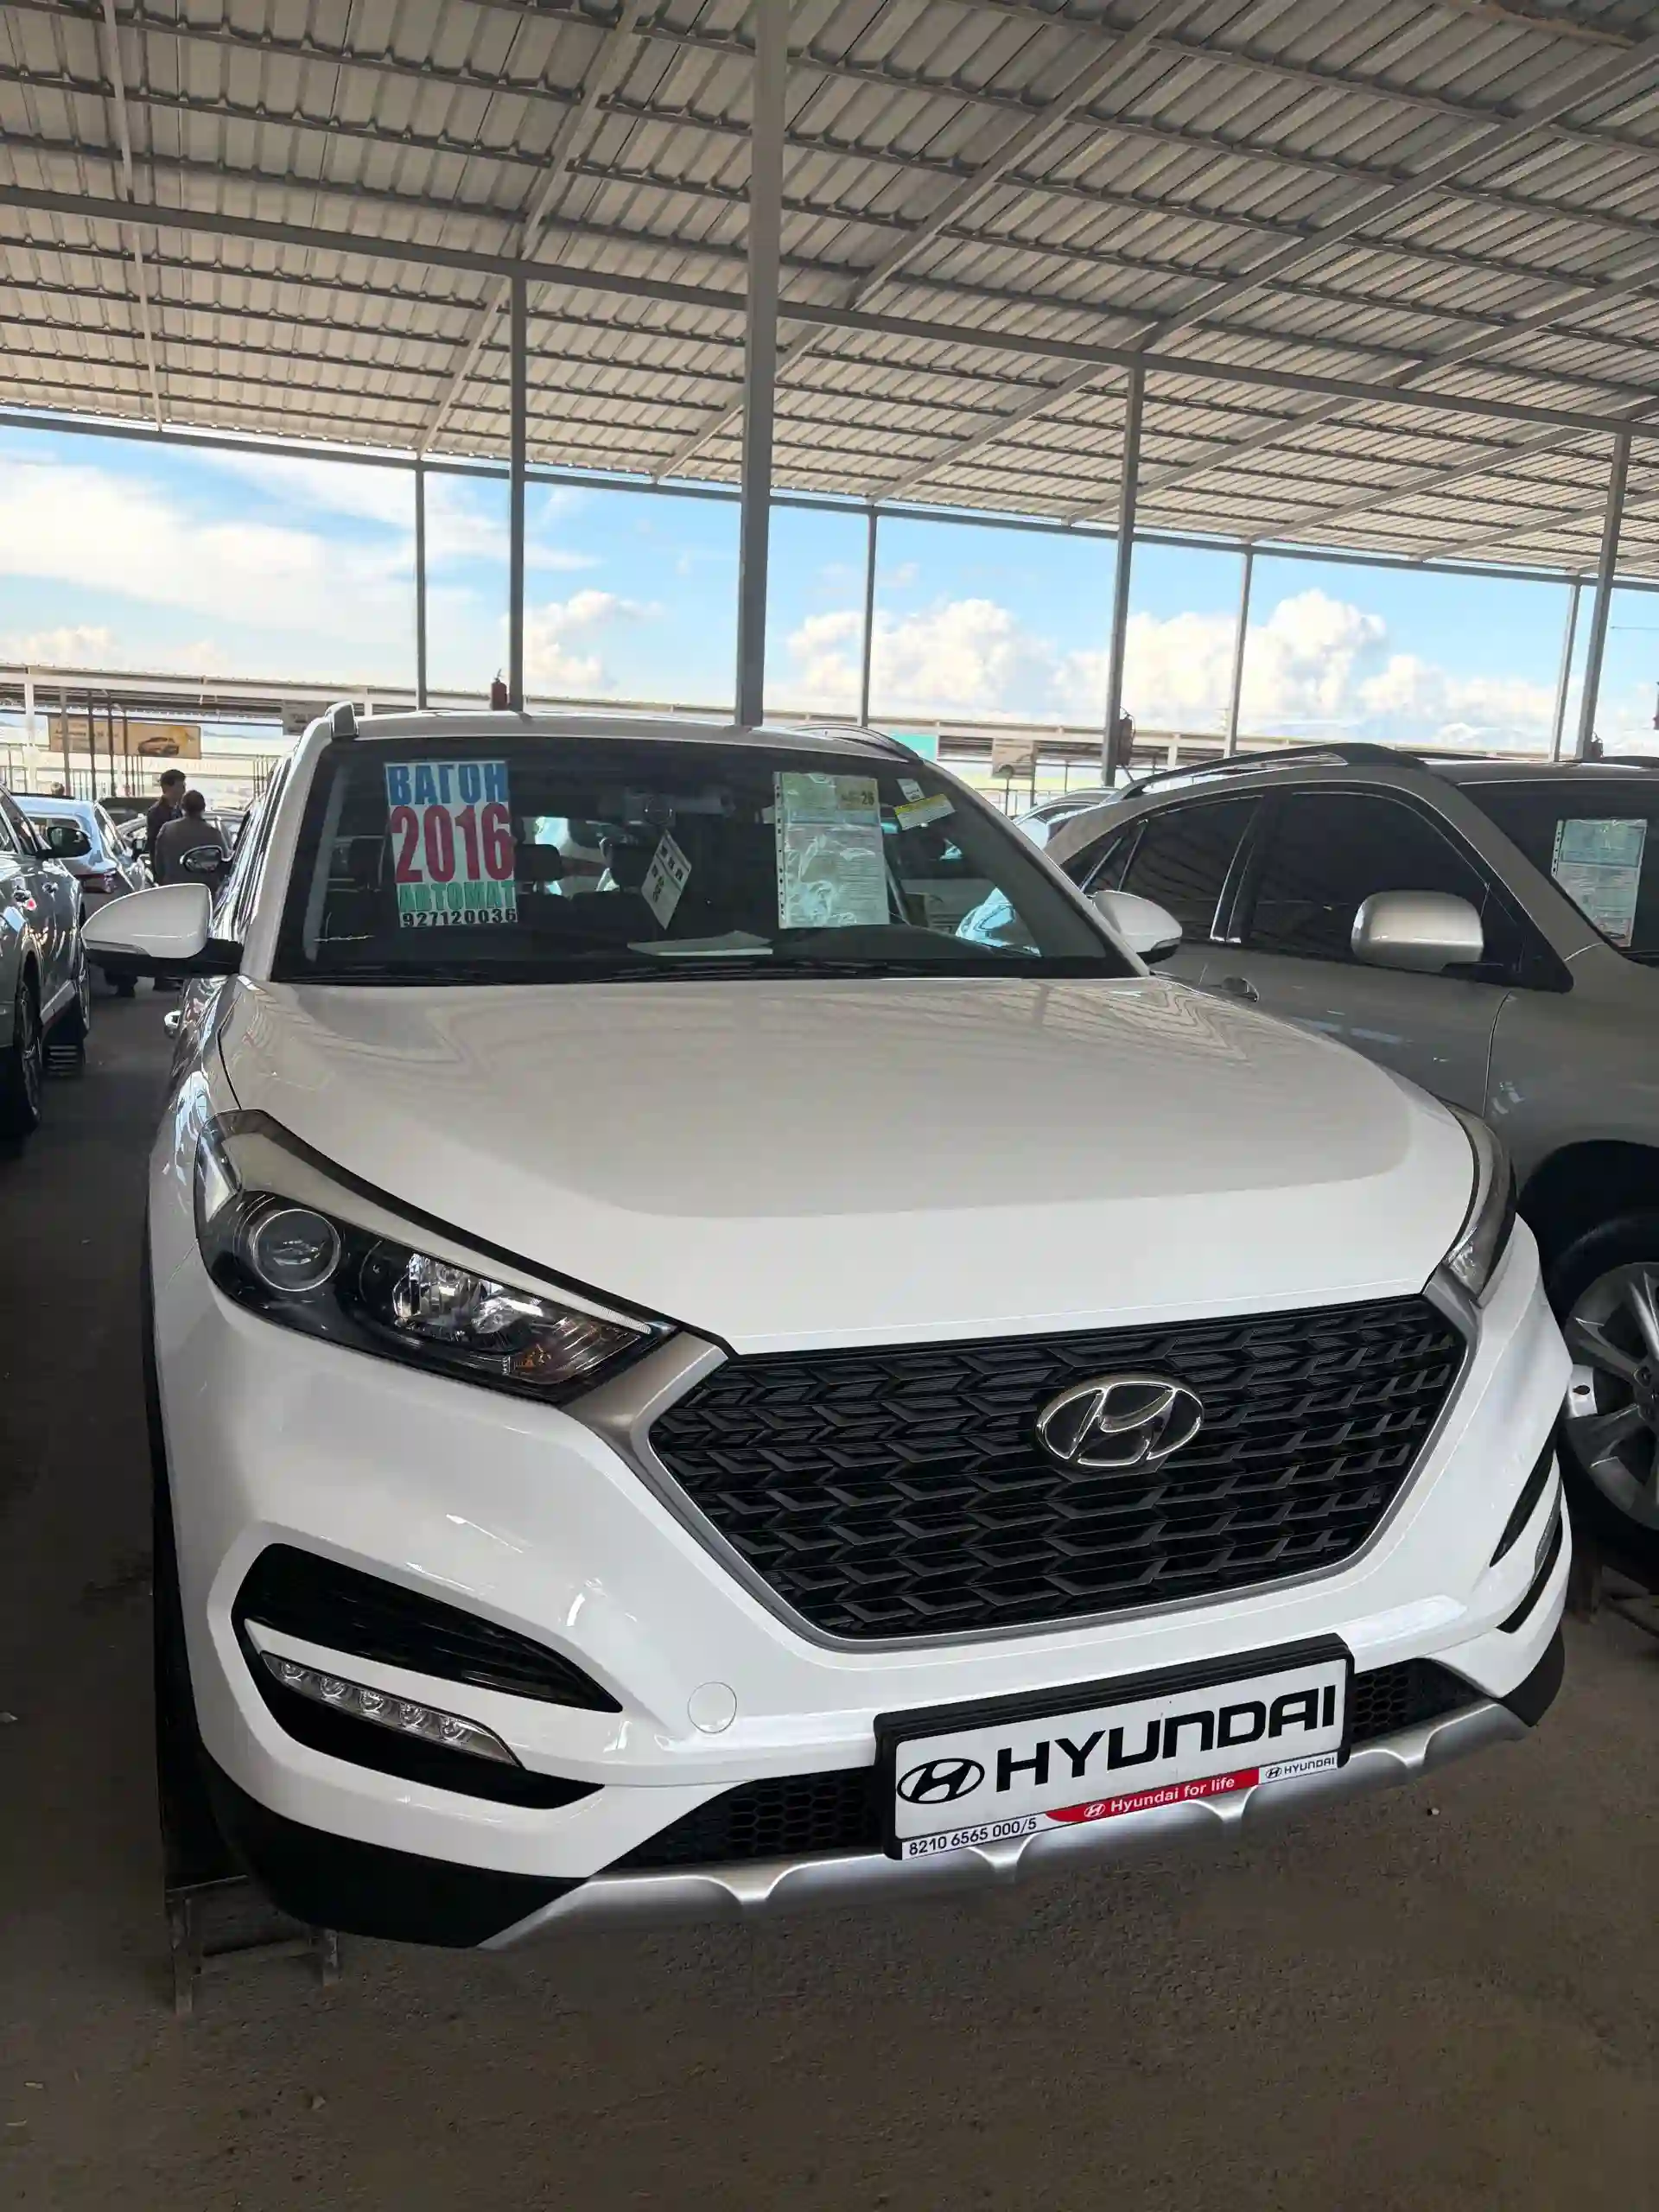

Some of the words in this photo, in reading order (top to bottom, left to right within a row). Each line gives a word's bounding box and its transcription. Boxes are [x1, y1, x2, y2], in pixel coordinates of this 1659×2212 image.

[389, 764, 508, 805] ВАГОН
[391, 802, 514, 883] 2016
[399, 880, 515, 912] АВТОМАТ
[403, 908, 517, 927] 927120036
[996, 1685, 1337, 1792] HYUNDAI
[1284, 1758, 1335, 1774] HYUNDAI
[1110, 1790, 1179, 1813] Hyundai
[1184, 1783, 1207, 1798] for
[1211, 1777, 1235, 1792] life
[909, 1836, 946, 1855] 8210
[951, 1827, 988, 1847] 6565
[993, 1818, 1037, 1837] 000/5
